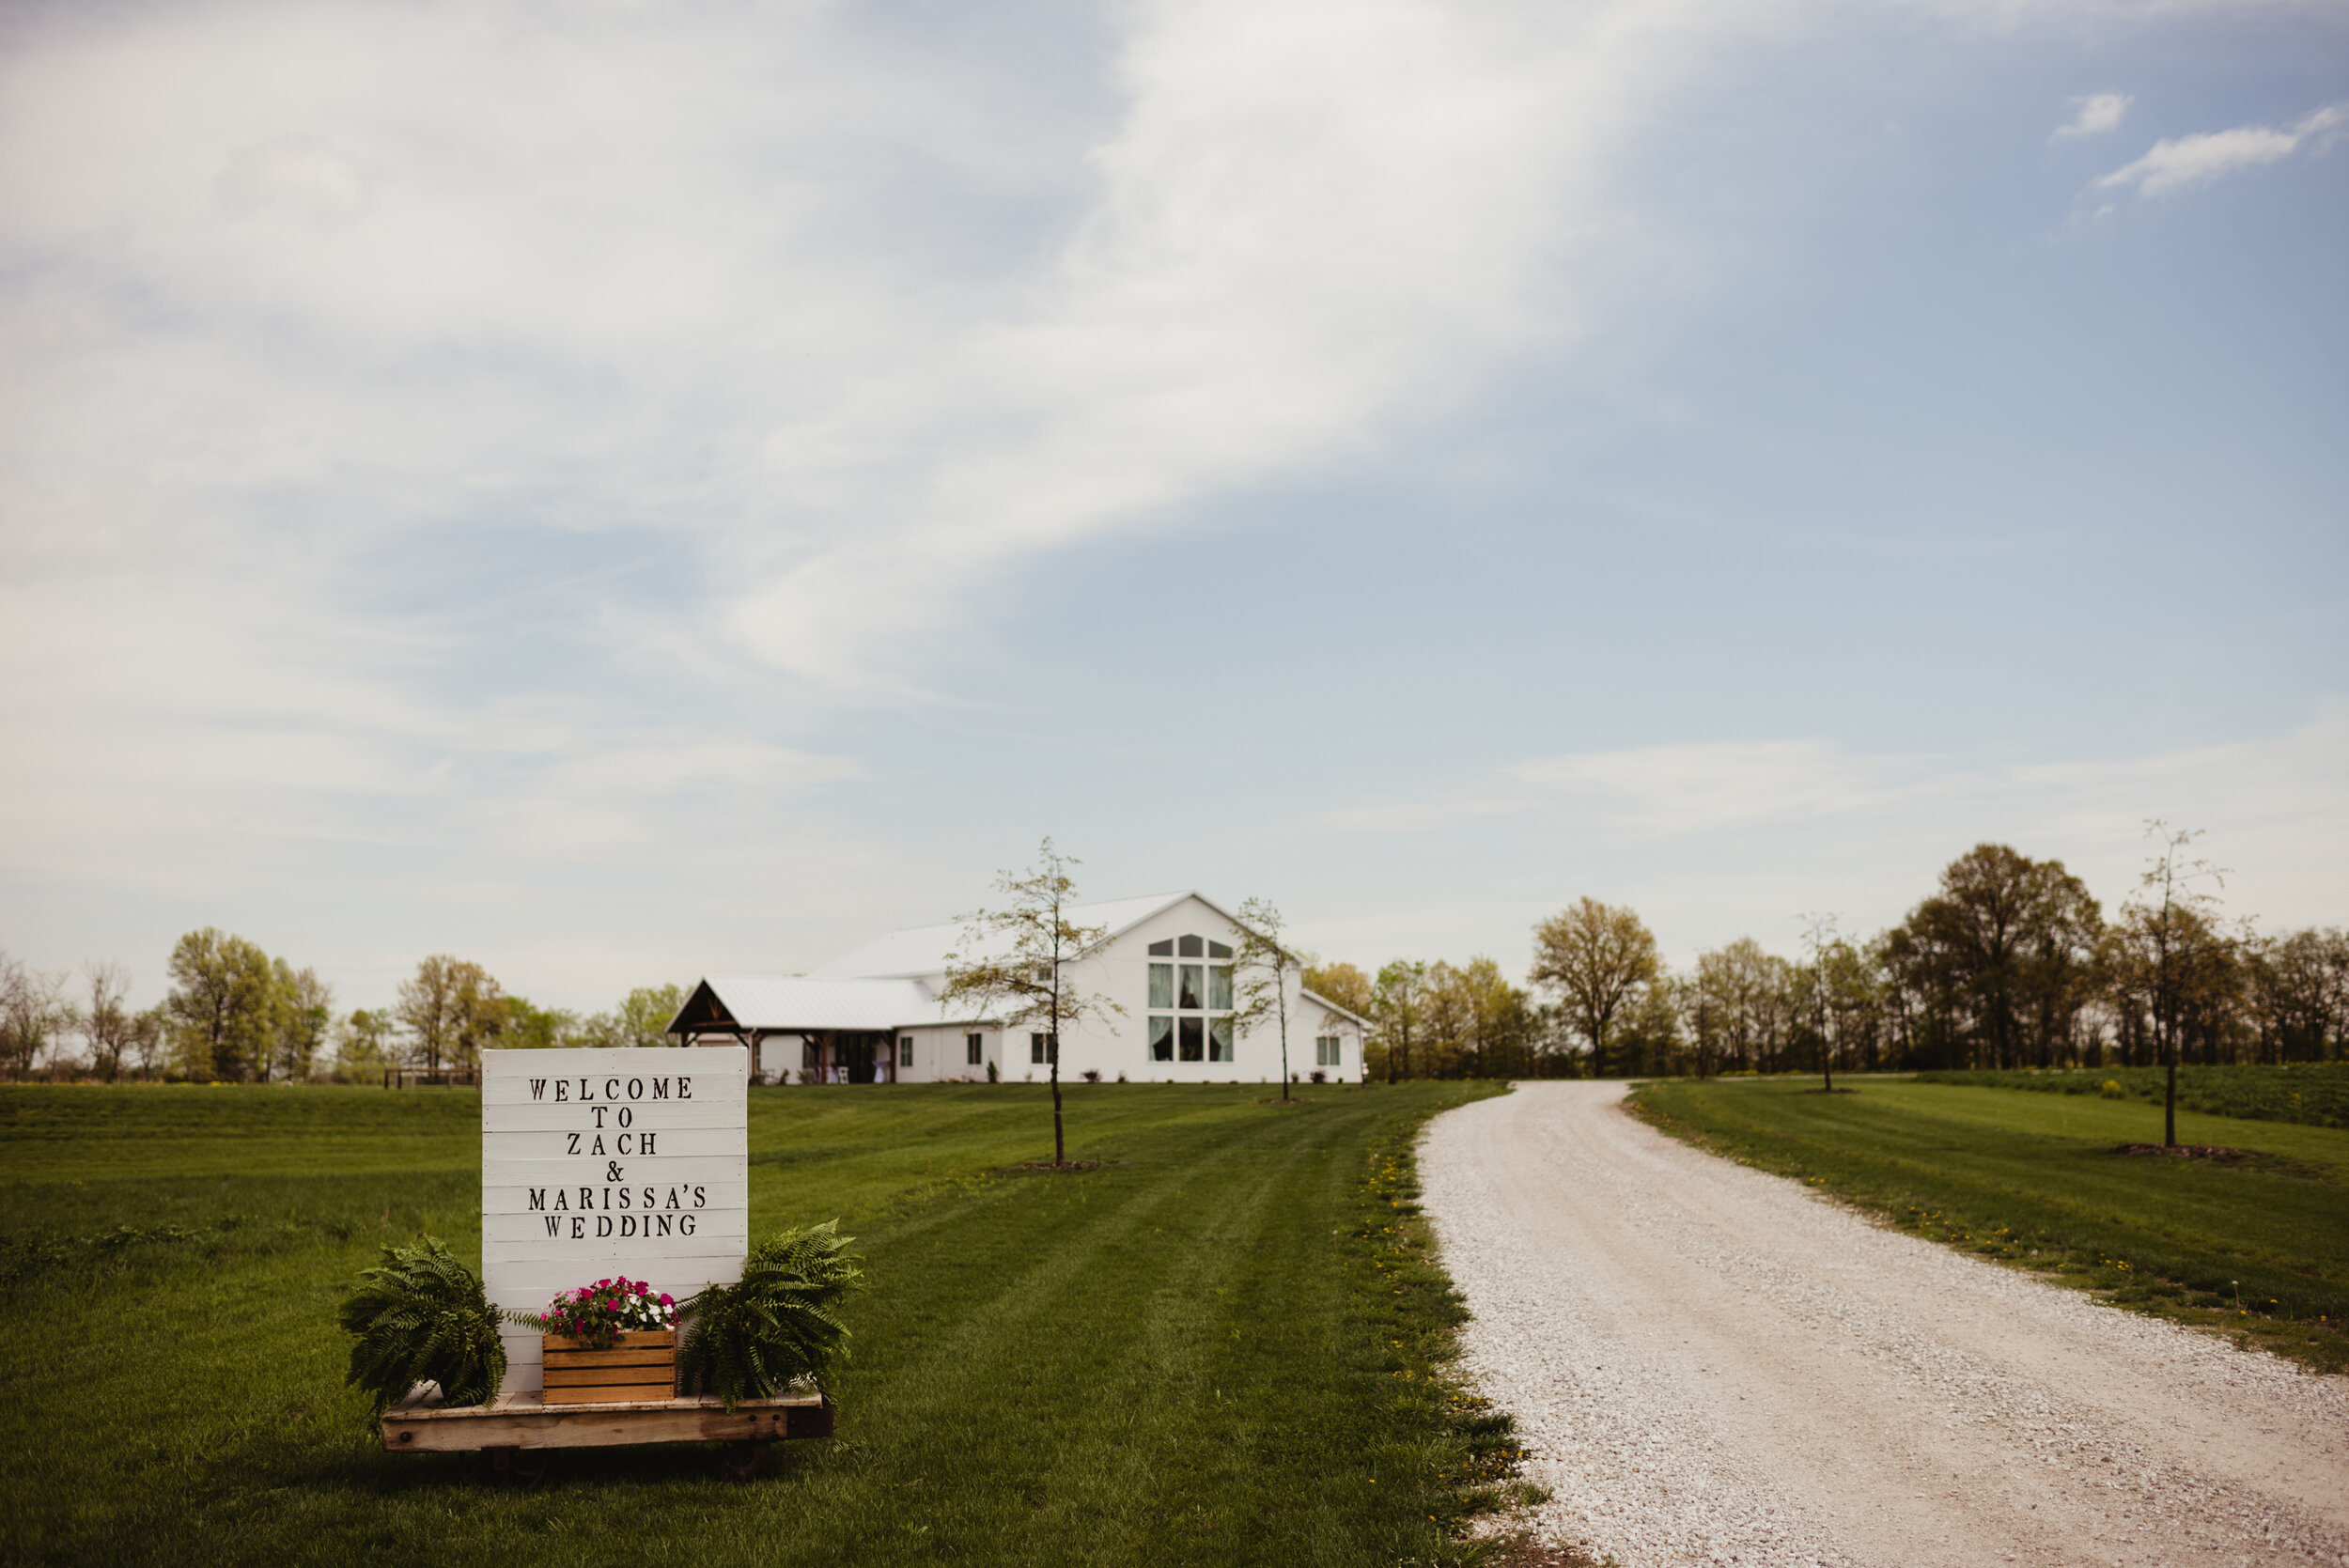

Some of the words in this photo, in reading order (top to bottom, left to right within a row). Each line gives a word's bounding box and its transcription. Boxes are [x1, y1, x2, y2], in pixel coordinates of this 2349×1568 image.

[529, 1077, 692, 1103] WELCOME
[591, 1106, 633, 1129] TO
[567, 1132, 657, 1156] ZACH
[606, 1160, 624, 1183] &
[528, 1184, 707, 1211] MARISSA'S
[544, 1214, 696, 1239] WEDDING
